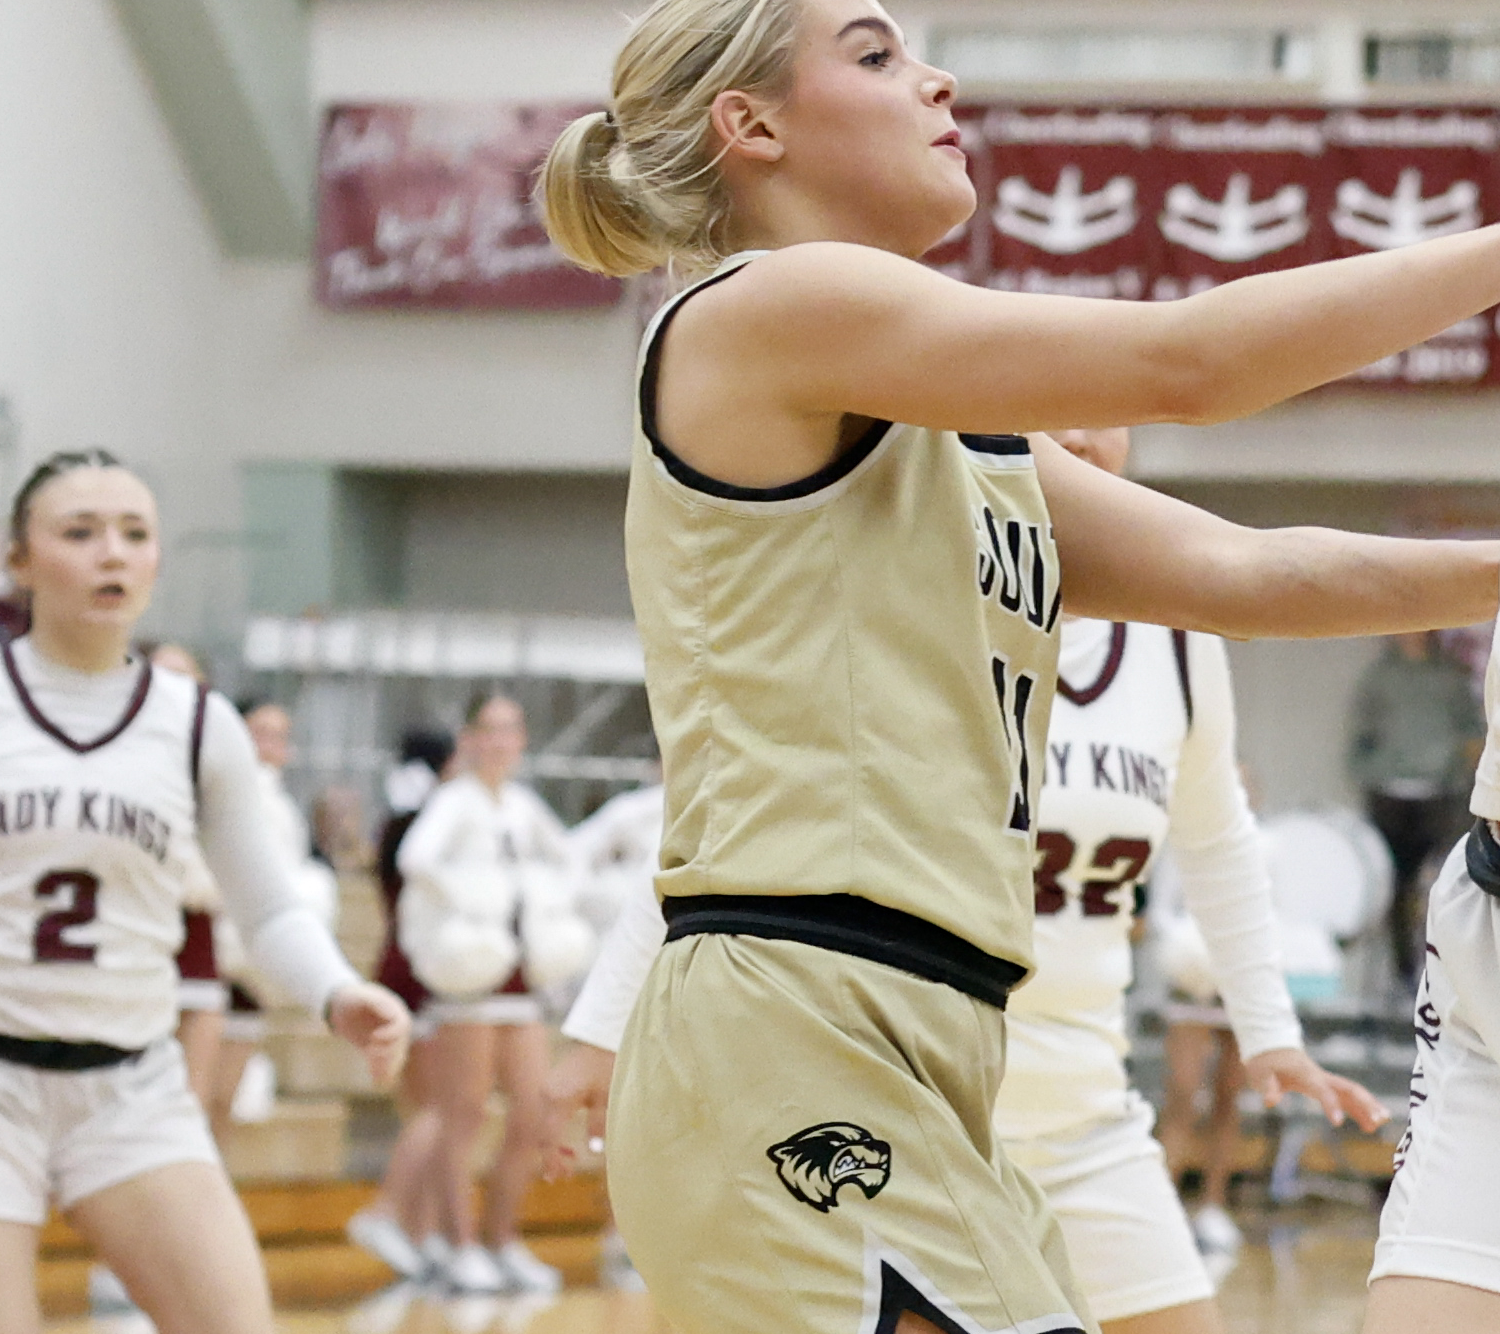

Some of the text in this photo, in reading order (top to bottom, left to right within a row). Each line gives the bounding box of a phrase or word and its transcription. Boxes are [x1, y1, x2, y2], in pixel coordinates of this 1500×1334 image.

[78, 783, 173, 866] KINGS
[34, 869, 102, 963] 2
[1035, 830, 1153, 918] 32
